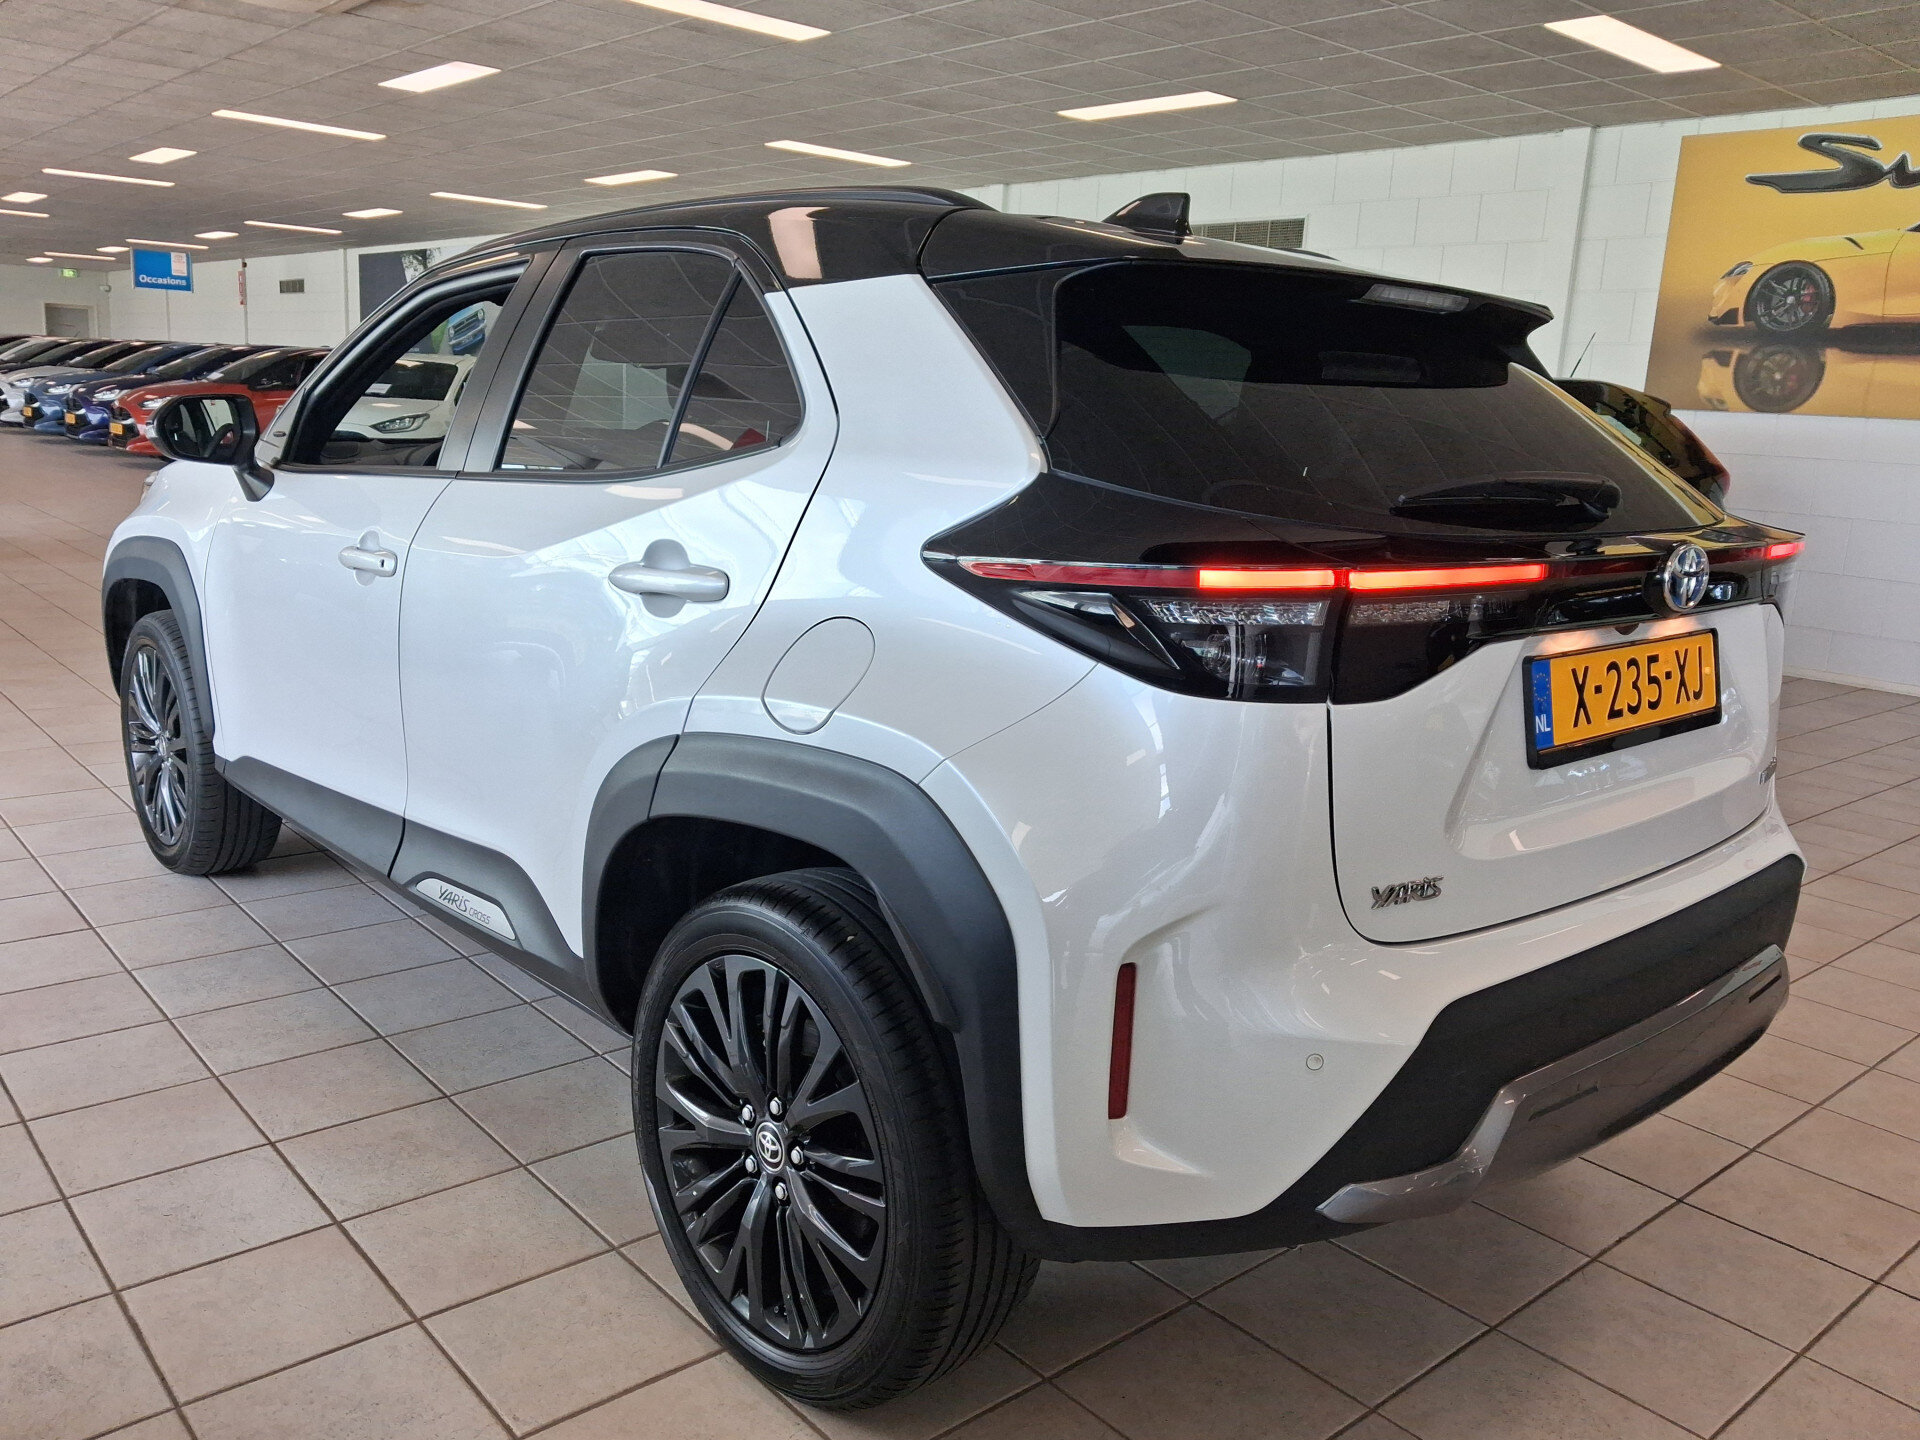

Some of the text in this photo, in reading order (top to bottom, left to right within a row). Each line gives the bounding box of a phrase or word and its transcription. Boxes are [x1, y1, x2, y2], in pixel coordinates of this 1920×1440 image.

[138, 274, 187, 286] Occasions
[1570, 645, 1703, 728] X-235-XJ
[1535, 714, 1551, 733] NL
[469, 907, 492, 925] CROSS
